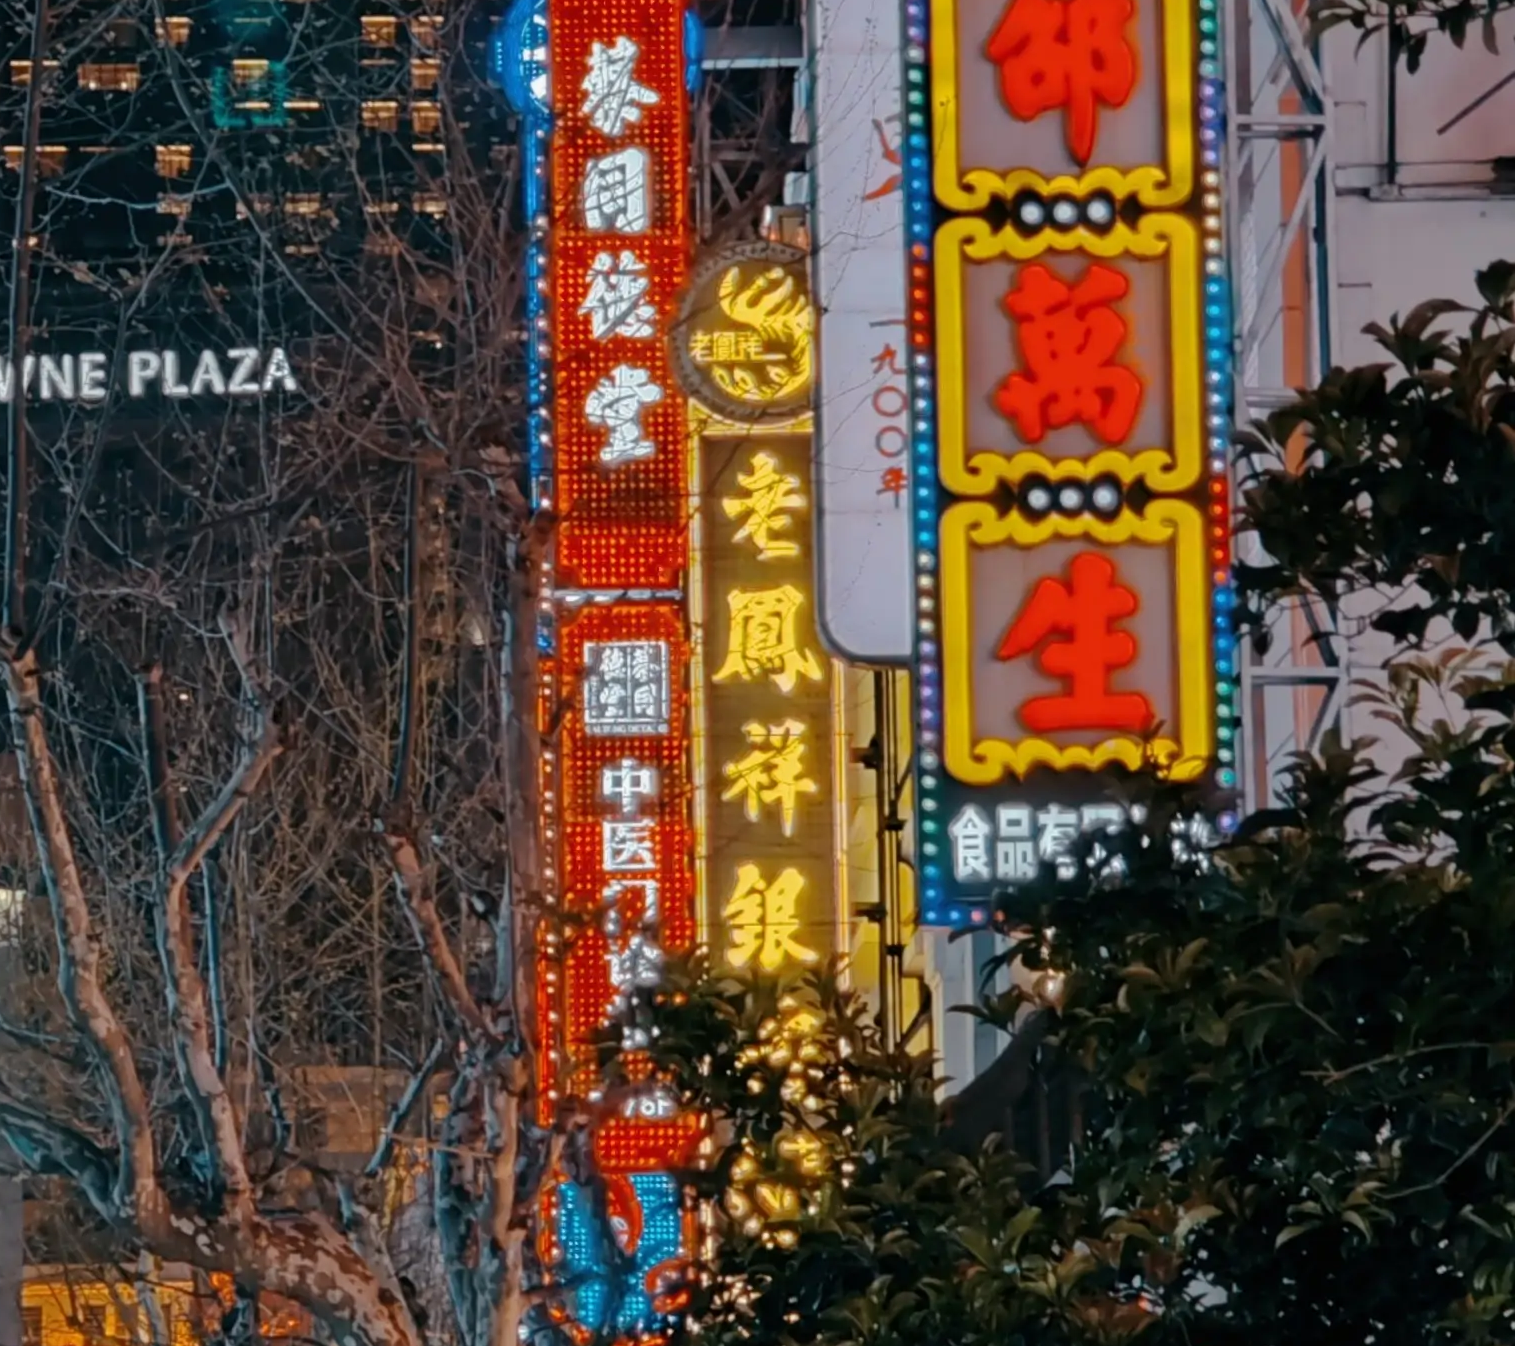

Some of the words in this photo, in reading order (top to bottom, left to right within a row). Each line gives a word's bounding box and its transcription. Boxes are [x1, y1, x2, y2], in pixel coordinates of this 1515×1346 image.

[128, 346, 296, 397] PLAZA
[601, 757, 660, 1045] 中医门诊
